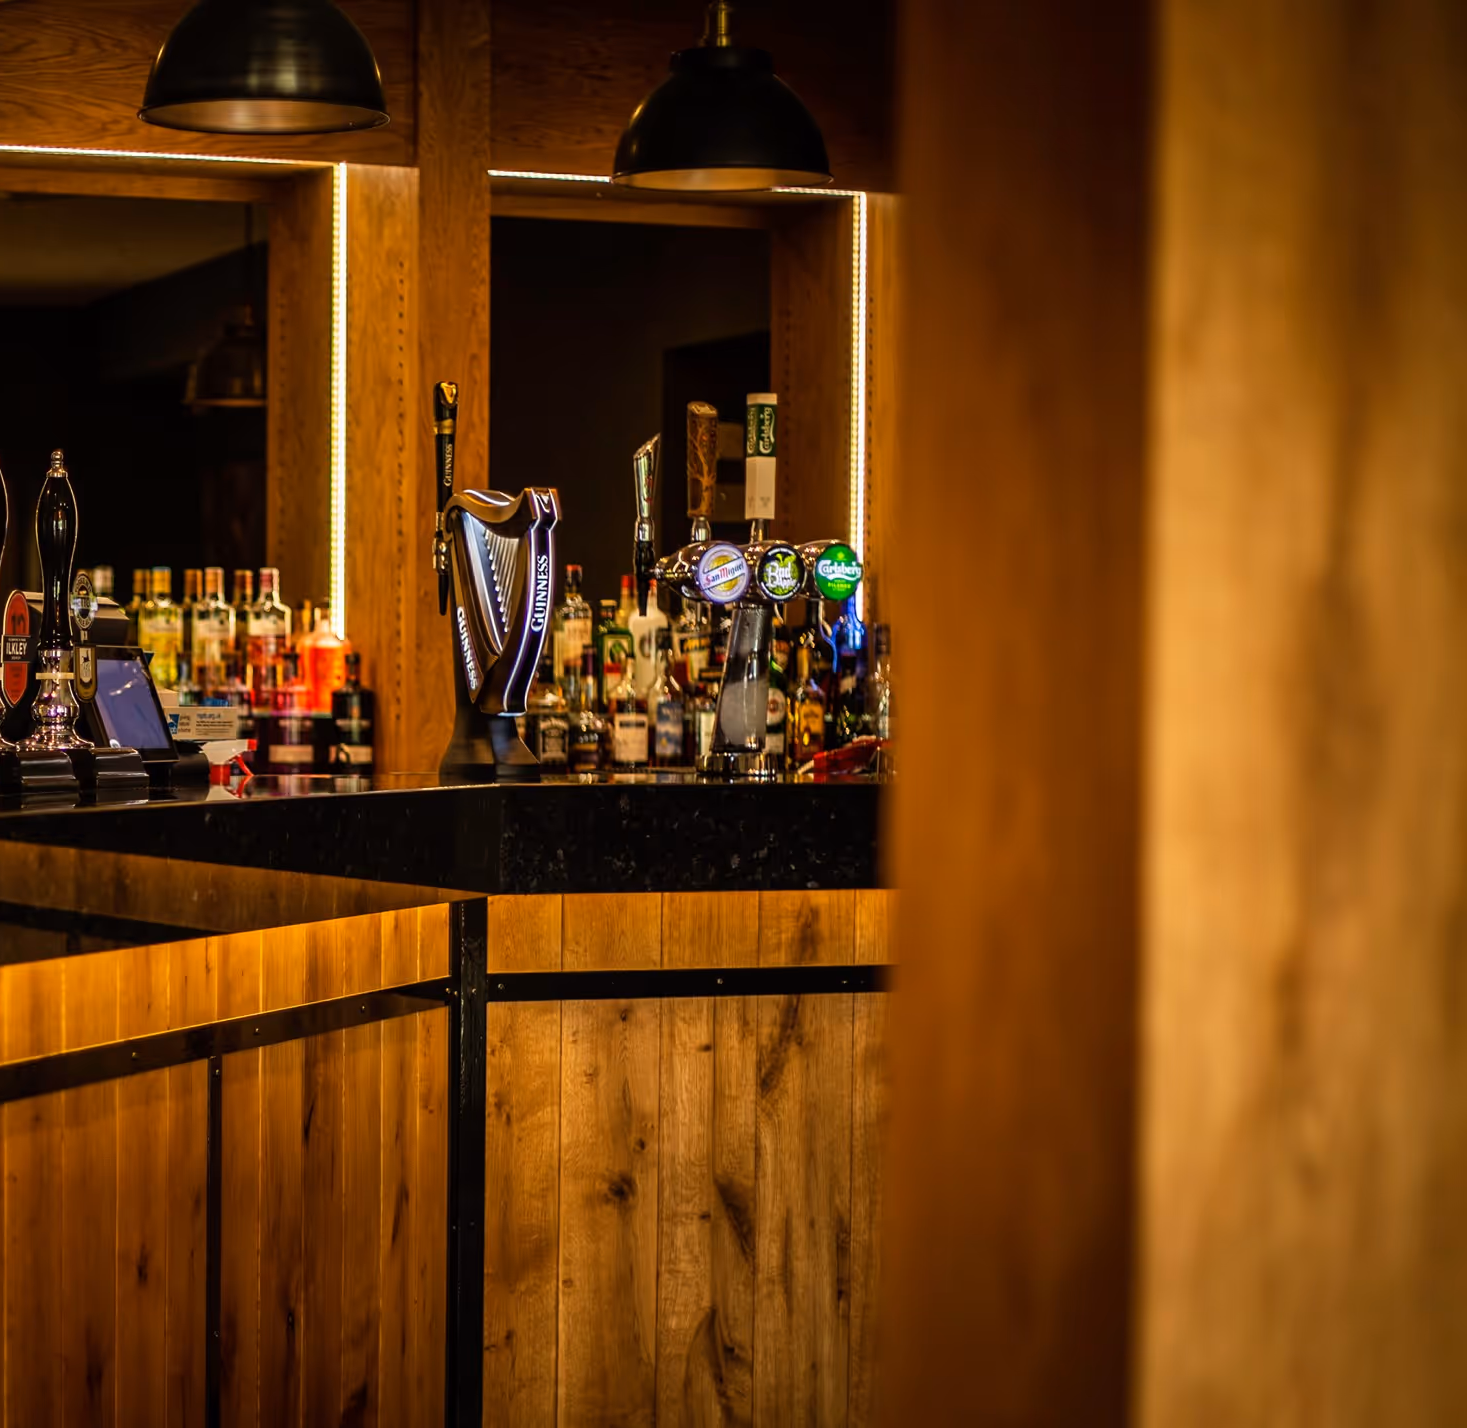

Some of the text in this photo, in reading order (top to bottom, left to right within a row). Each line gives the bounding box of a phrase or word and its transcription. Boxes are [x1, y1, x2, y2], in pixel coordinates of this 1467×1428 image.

[759, 406, 775, 454] Carlsberg
[443, 443, 453, 487] GUINNESS
[703, 560, 744, 587] San Miguel
[767, 560, 792, 588] Bad
[817, 559, 862, 582] Carlsberg
[531, 555, 549, 632] GUINNESS
[5, 642, 28, 655] ILKLEY
[456, 606, 480, 692] GUINNESS
